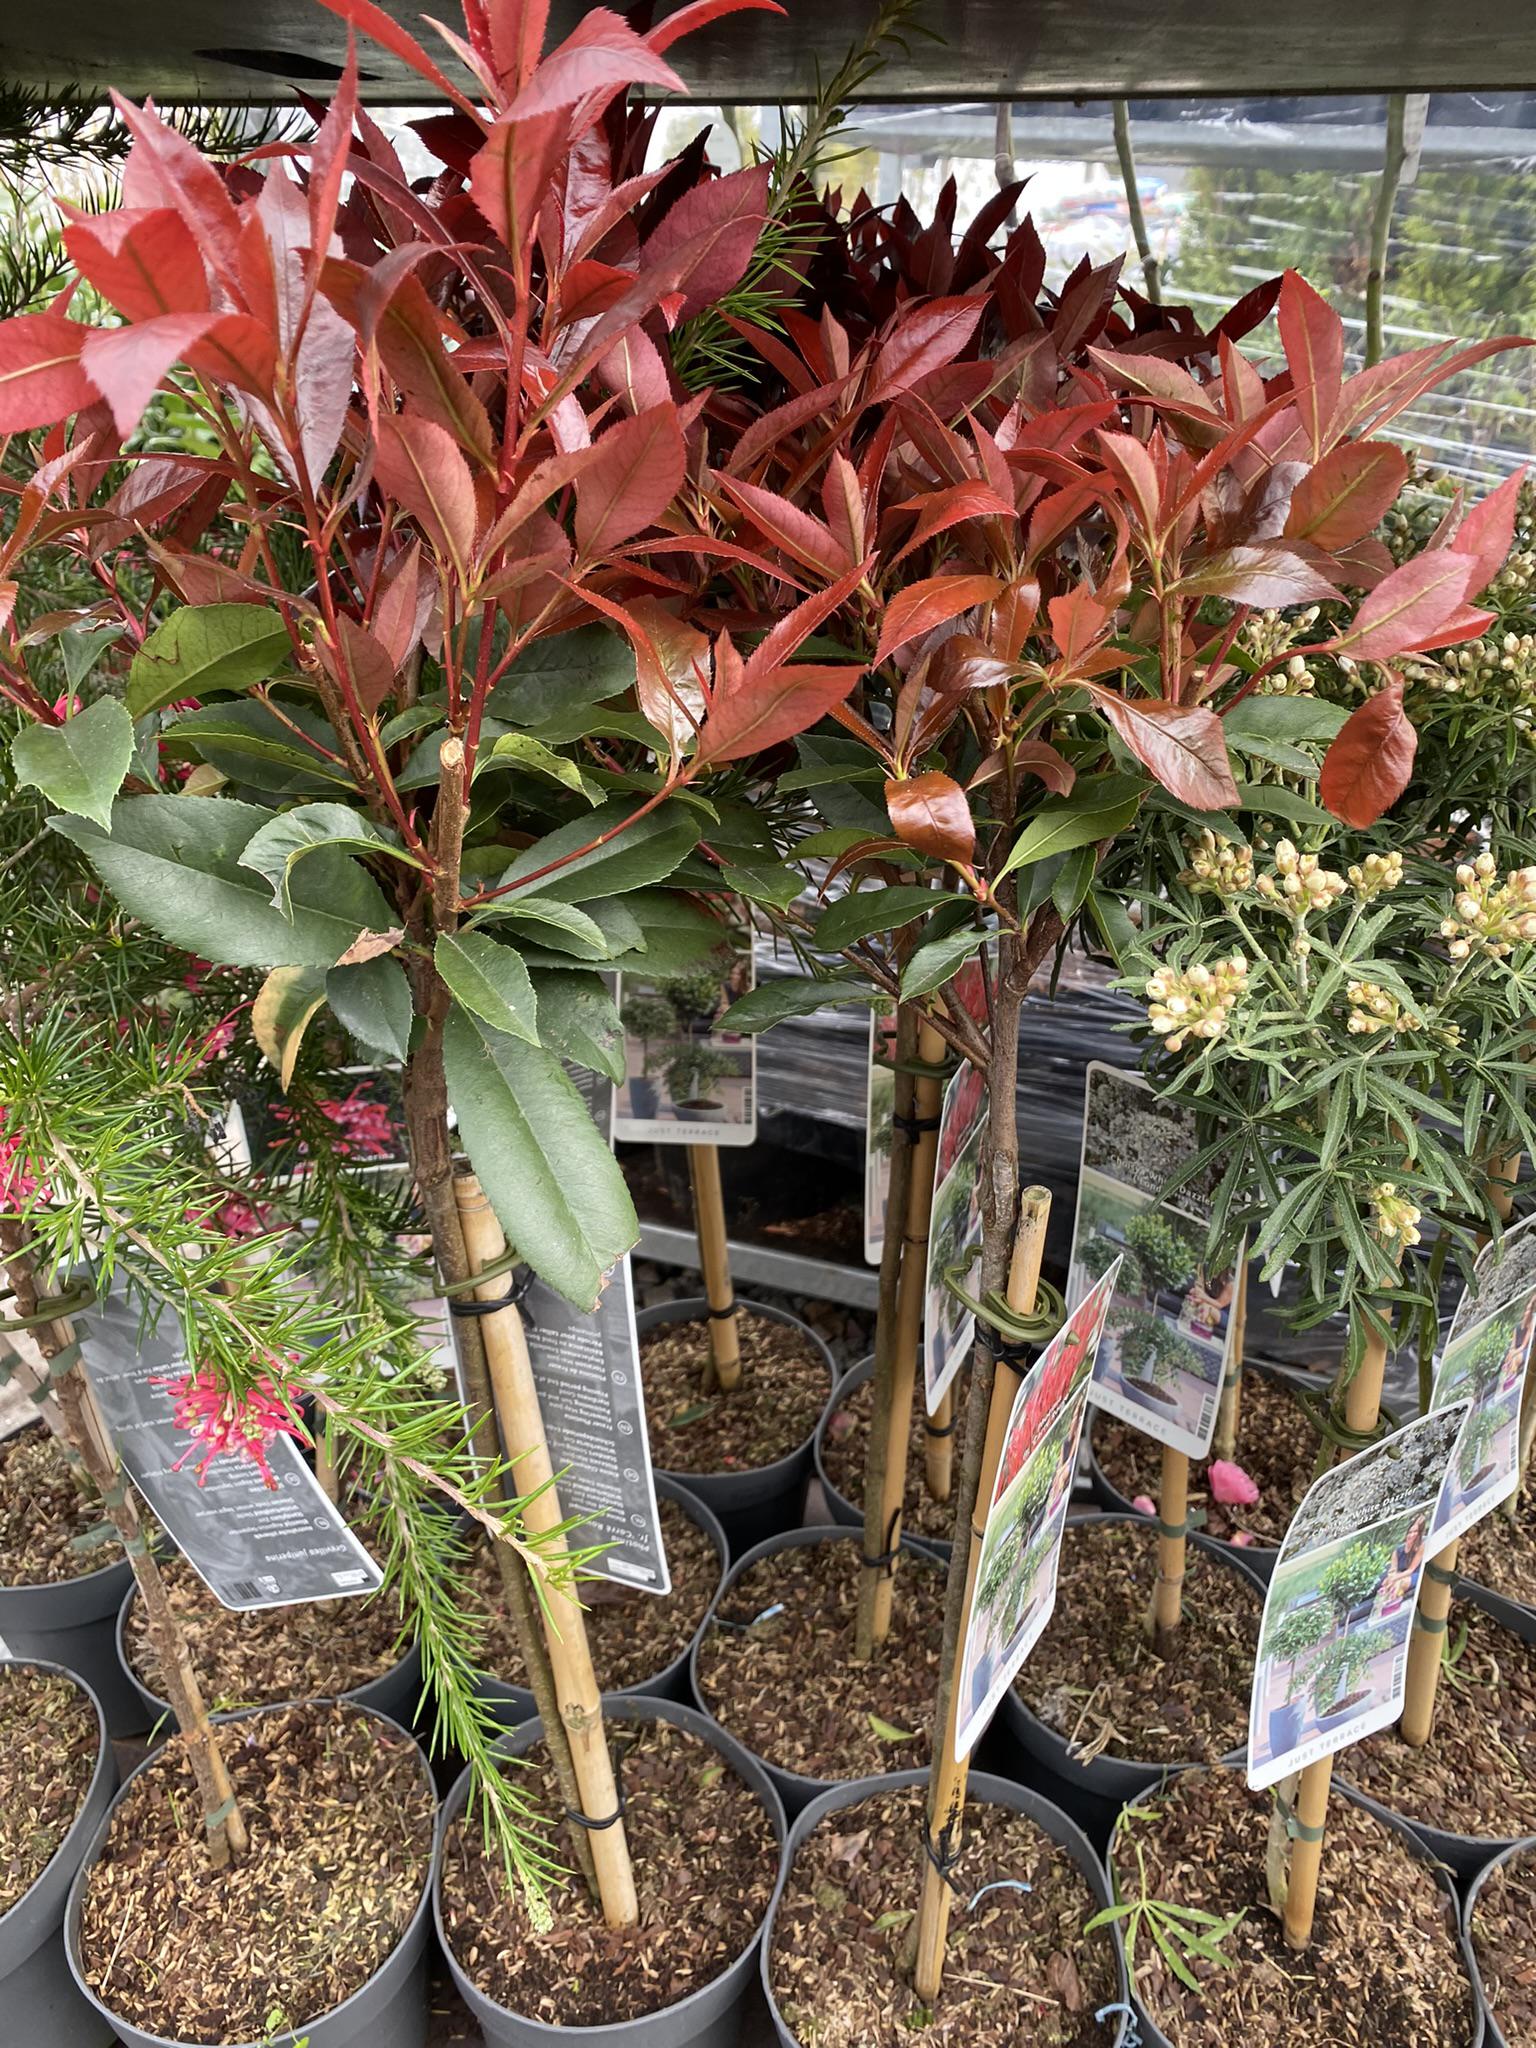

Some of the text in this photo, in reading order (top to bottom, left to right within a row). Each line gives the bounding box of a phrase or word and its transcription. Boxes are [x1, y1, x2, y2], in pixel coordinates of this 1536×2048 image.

[1090, 1388, 1168, 1435] JUST TERRACE
[1288, 1721, 1367, 1768] JUST TERRACE
